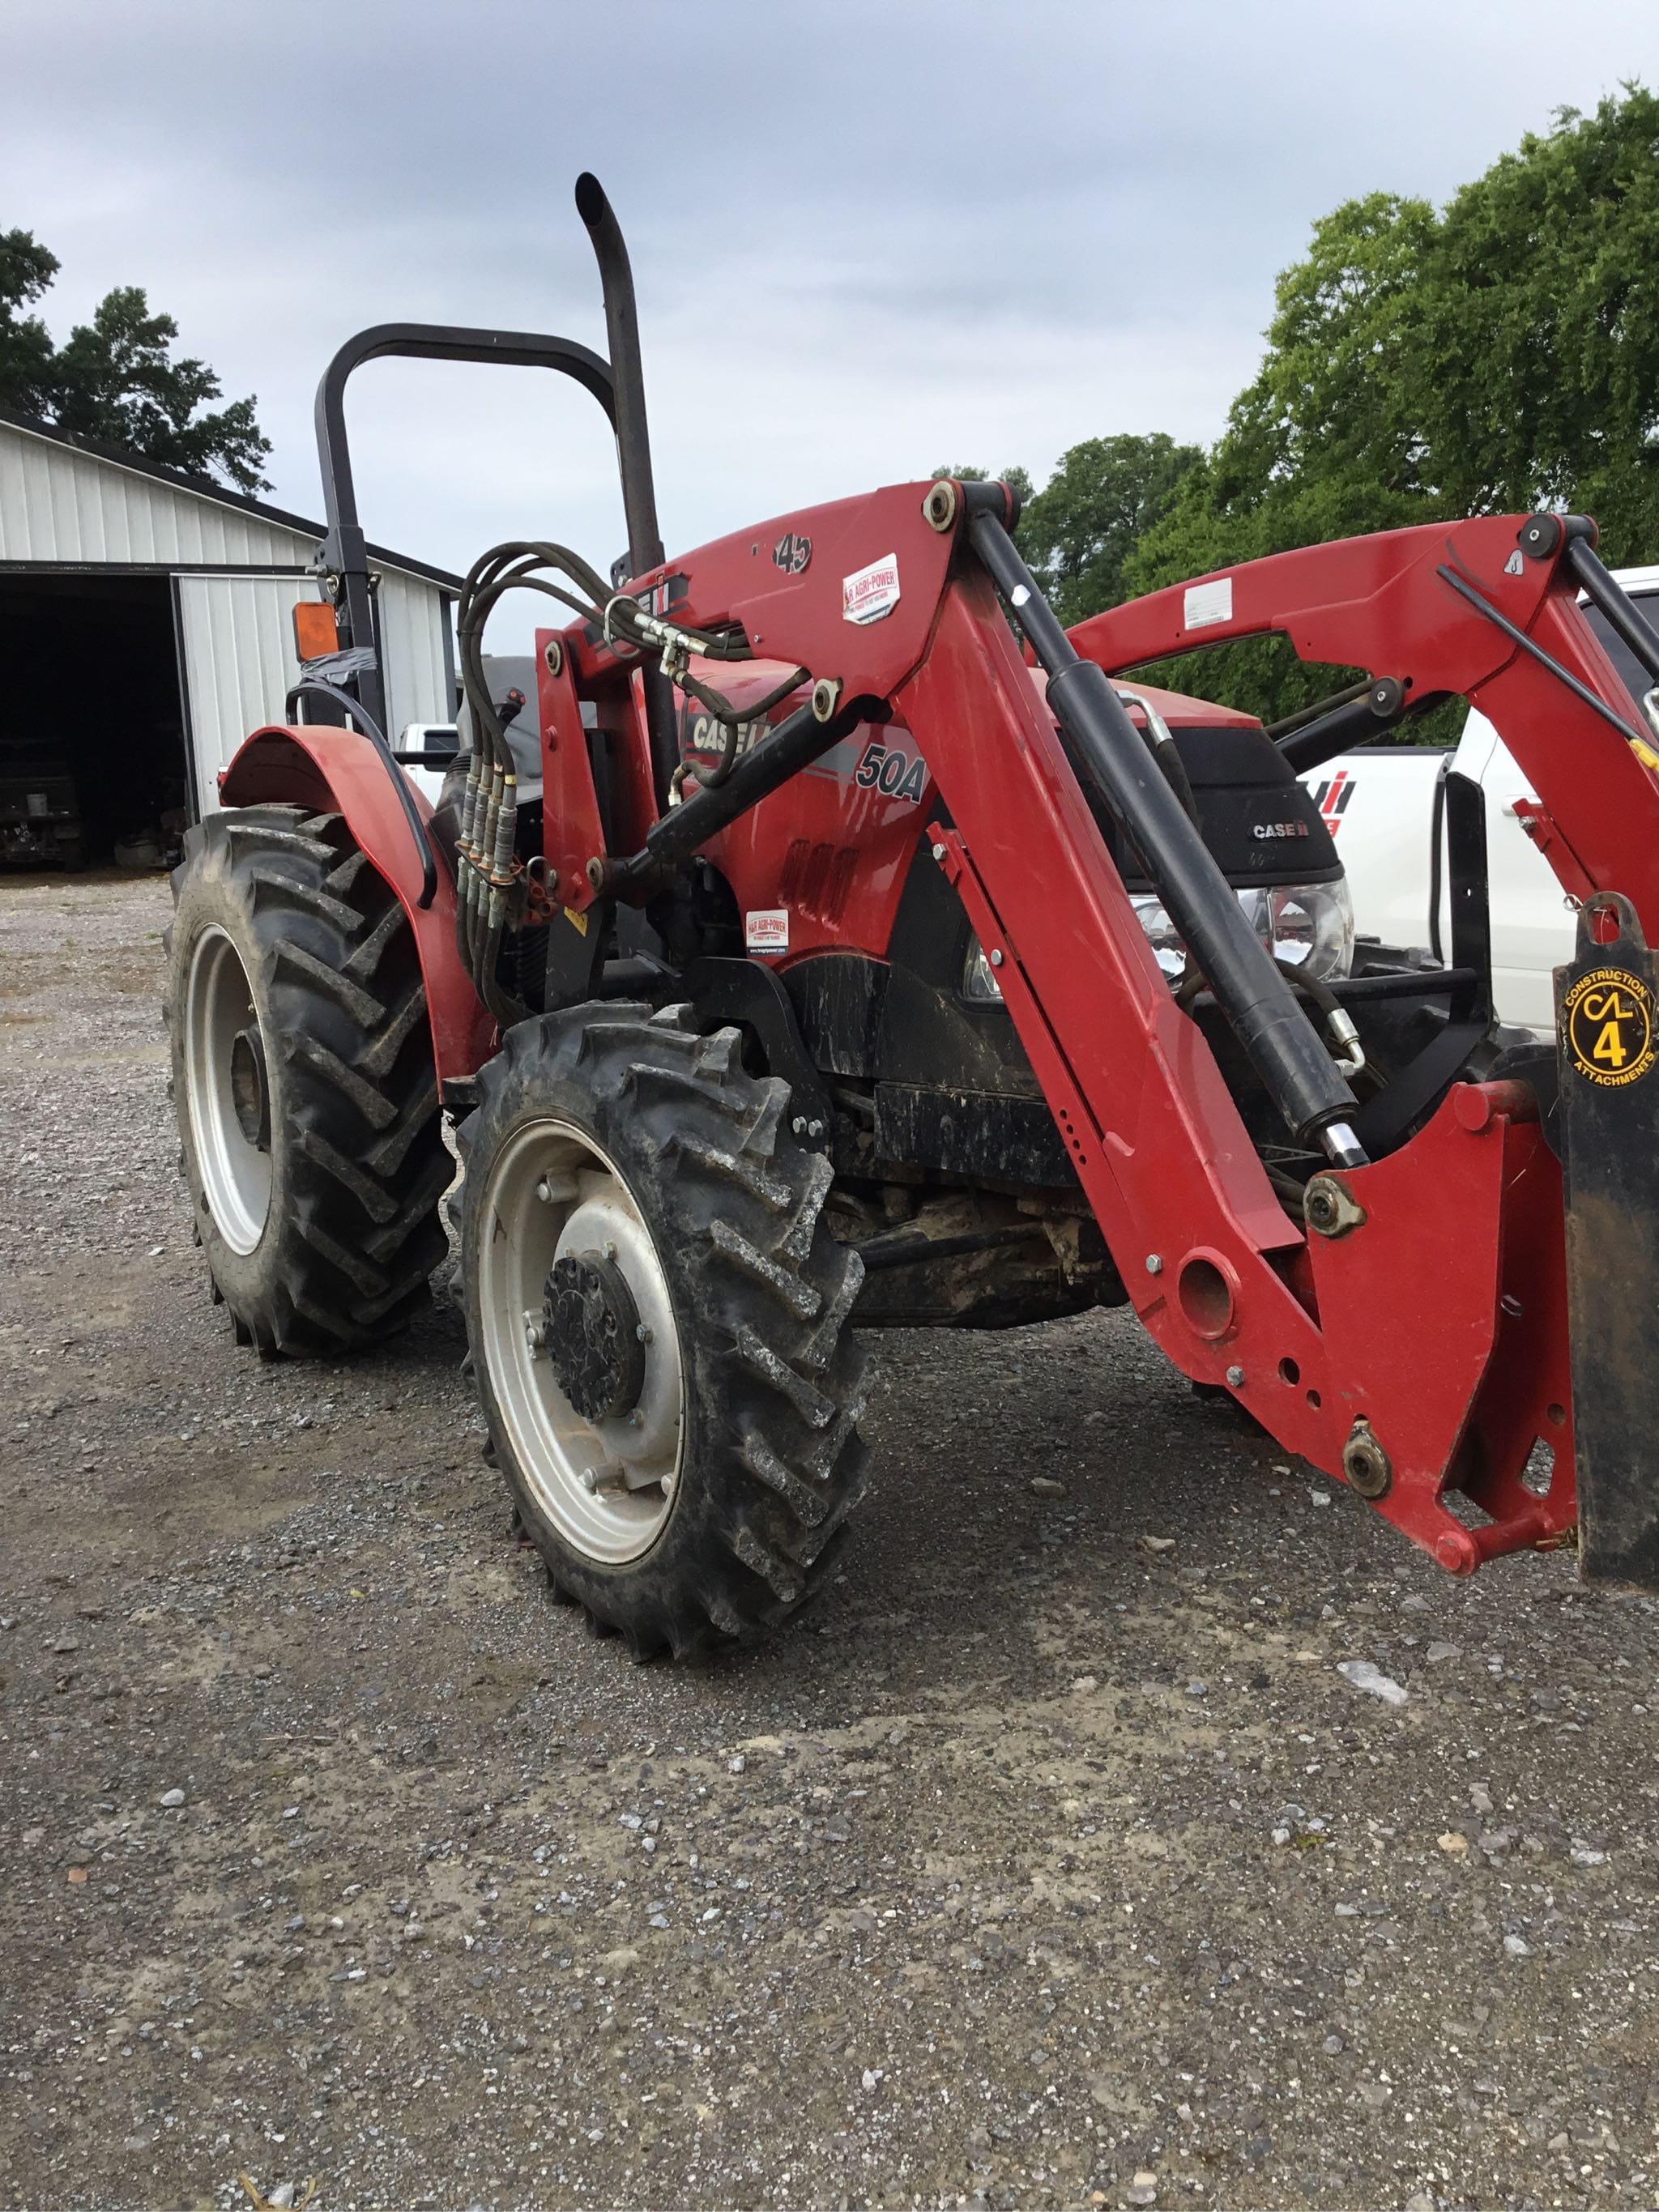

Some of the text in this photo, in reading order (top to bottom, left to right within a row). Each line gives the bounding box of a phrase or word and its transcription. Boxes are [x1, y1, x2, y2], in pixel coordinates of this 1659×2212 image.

[777, 532, 812, 573] 45
[855, 570, 895, 599] AGRI-POWER
[855, 744, 927, 804] 50A
[1253, 823, 1296, 839] CASE
[758, 918, 786, 935] AGRI-POWER
[1565, 970, 1648, 1007] CONSTRUCTION
[1593, 1021, 1627, 1068] 4
[1573, 1051, 1655, 1086] ATTACHMENTS
